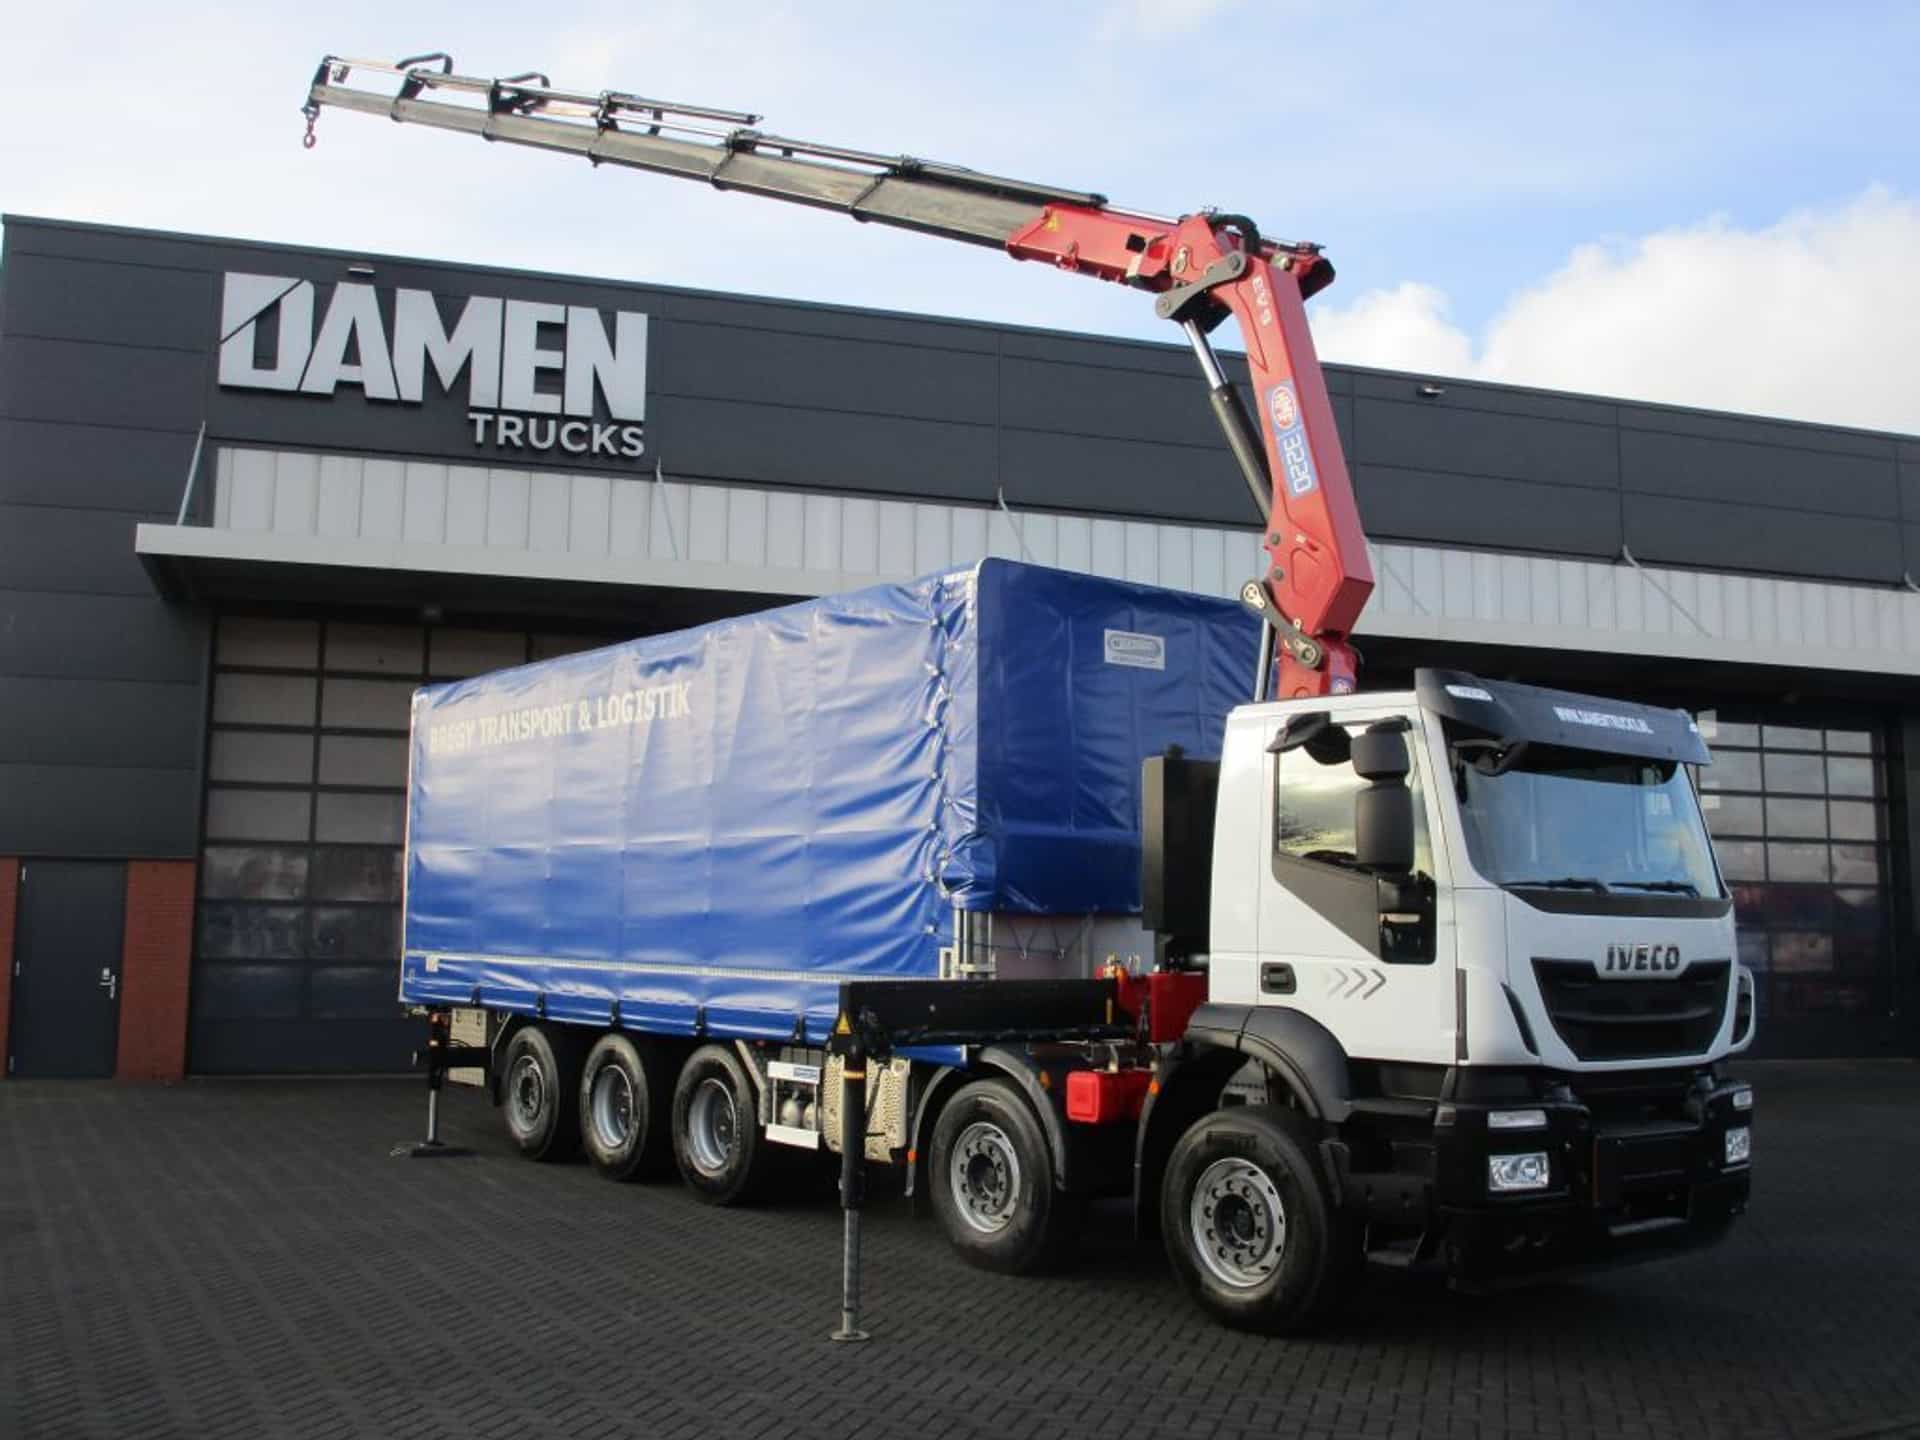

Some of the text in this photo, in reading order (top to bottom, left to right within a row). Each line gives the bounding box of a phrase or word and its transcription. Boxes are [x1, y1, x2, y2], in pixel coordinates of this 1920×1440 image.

[217, 271, 649, 422] DAMEN
[468, 413, 645, 457] TRUCKS
[479, 703, 574, 746] TRANSPORT
[579, 700, 593, 731] &
[597, 681, 691, 729] LOGISTIK
[1605, 945, 1681, 971] IVECO
